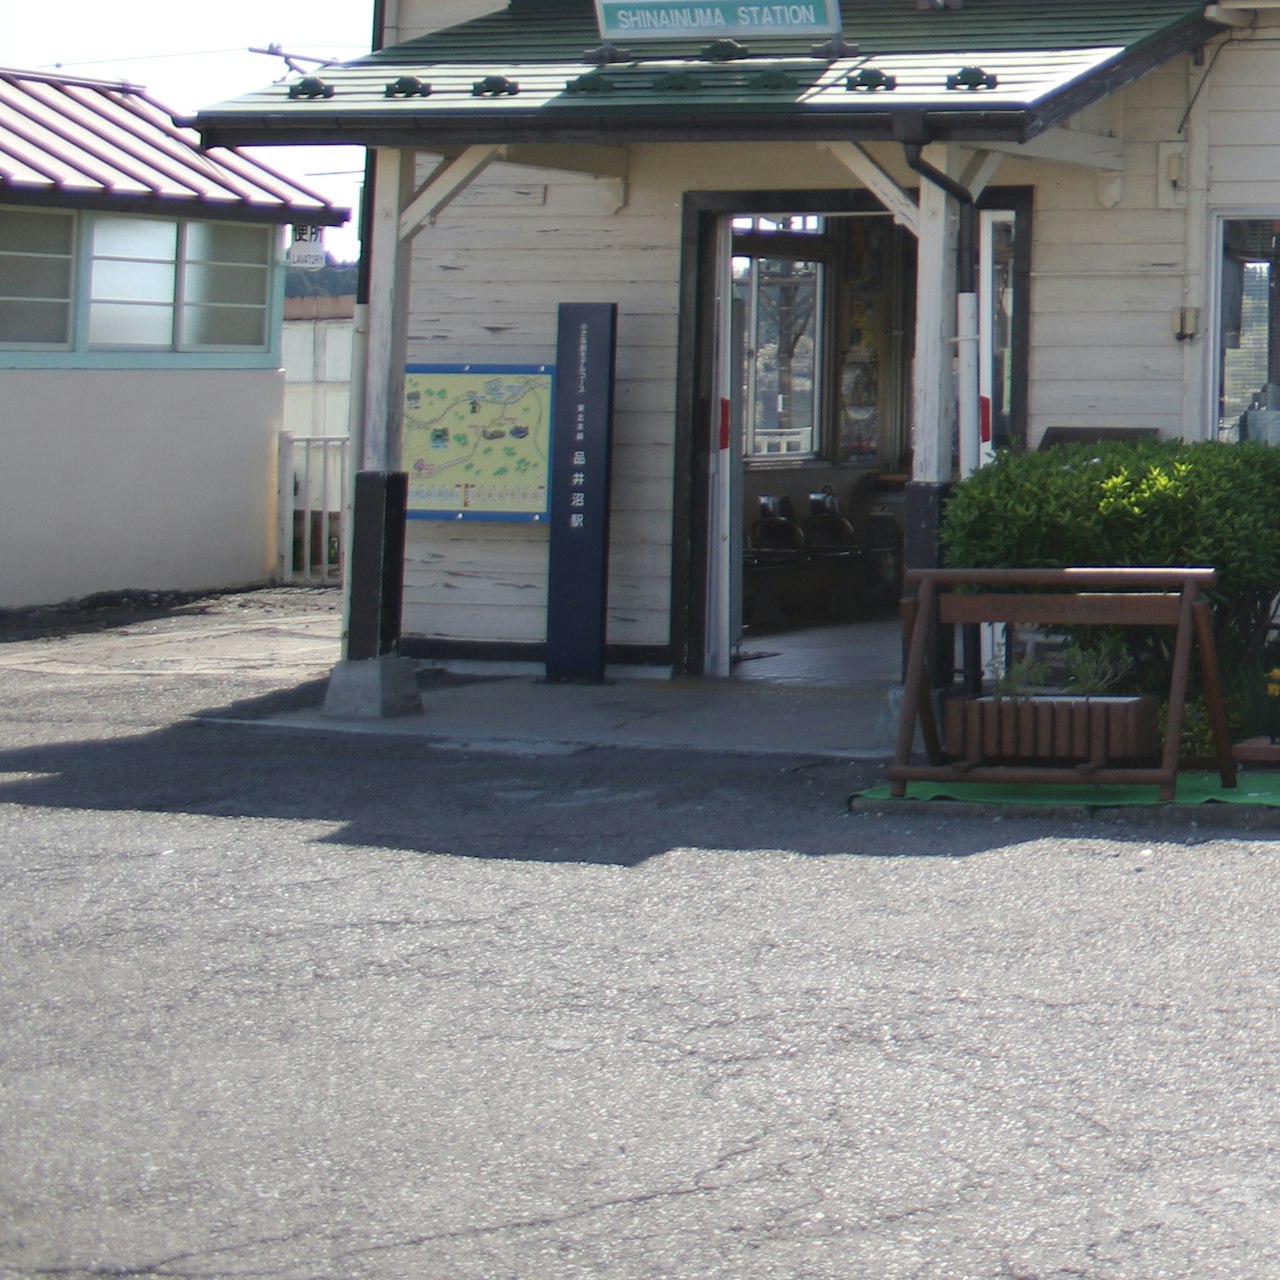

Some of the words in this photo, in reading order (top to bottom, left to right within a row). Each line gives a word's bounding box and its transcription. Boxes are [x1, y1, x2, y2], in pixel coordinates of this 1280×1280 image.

[618, 7, 726, 29] SHINAINUMA
[737, 5, 816, 26] STATION
[292, 224, 323, 243] 便所
[570, 451, 586, 527] 品井沼駅
